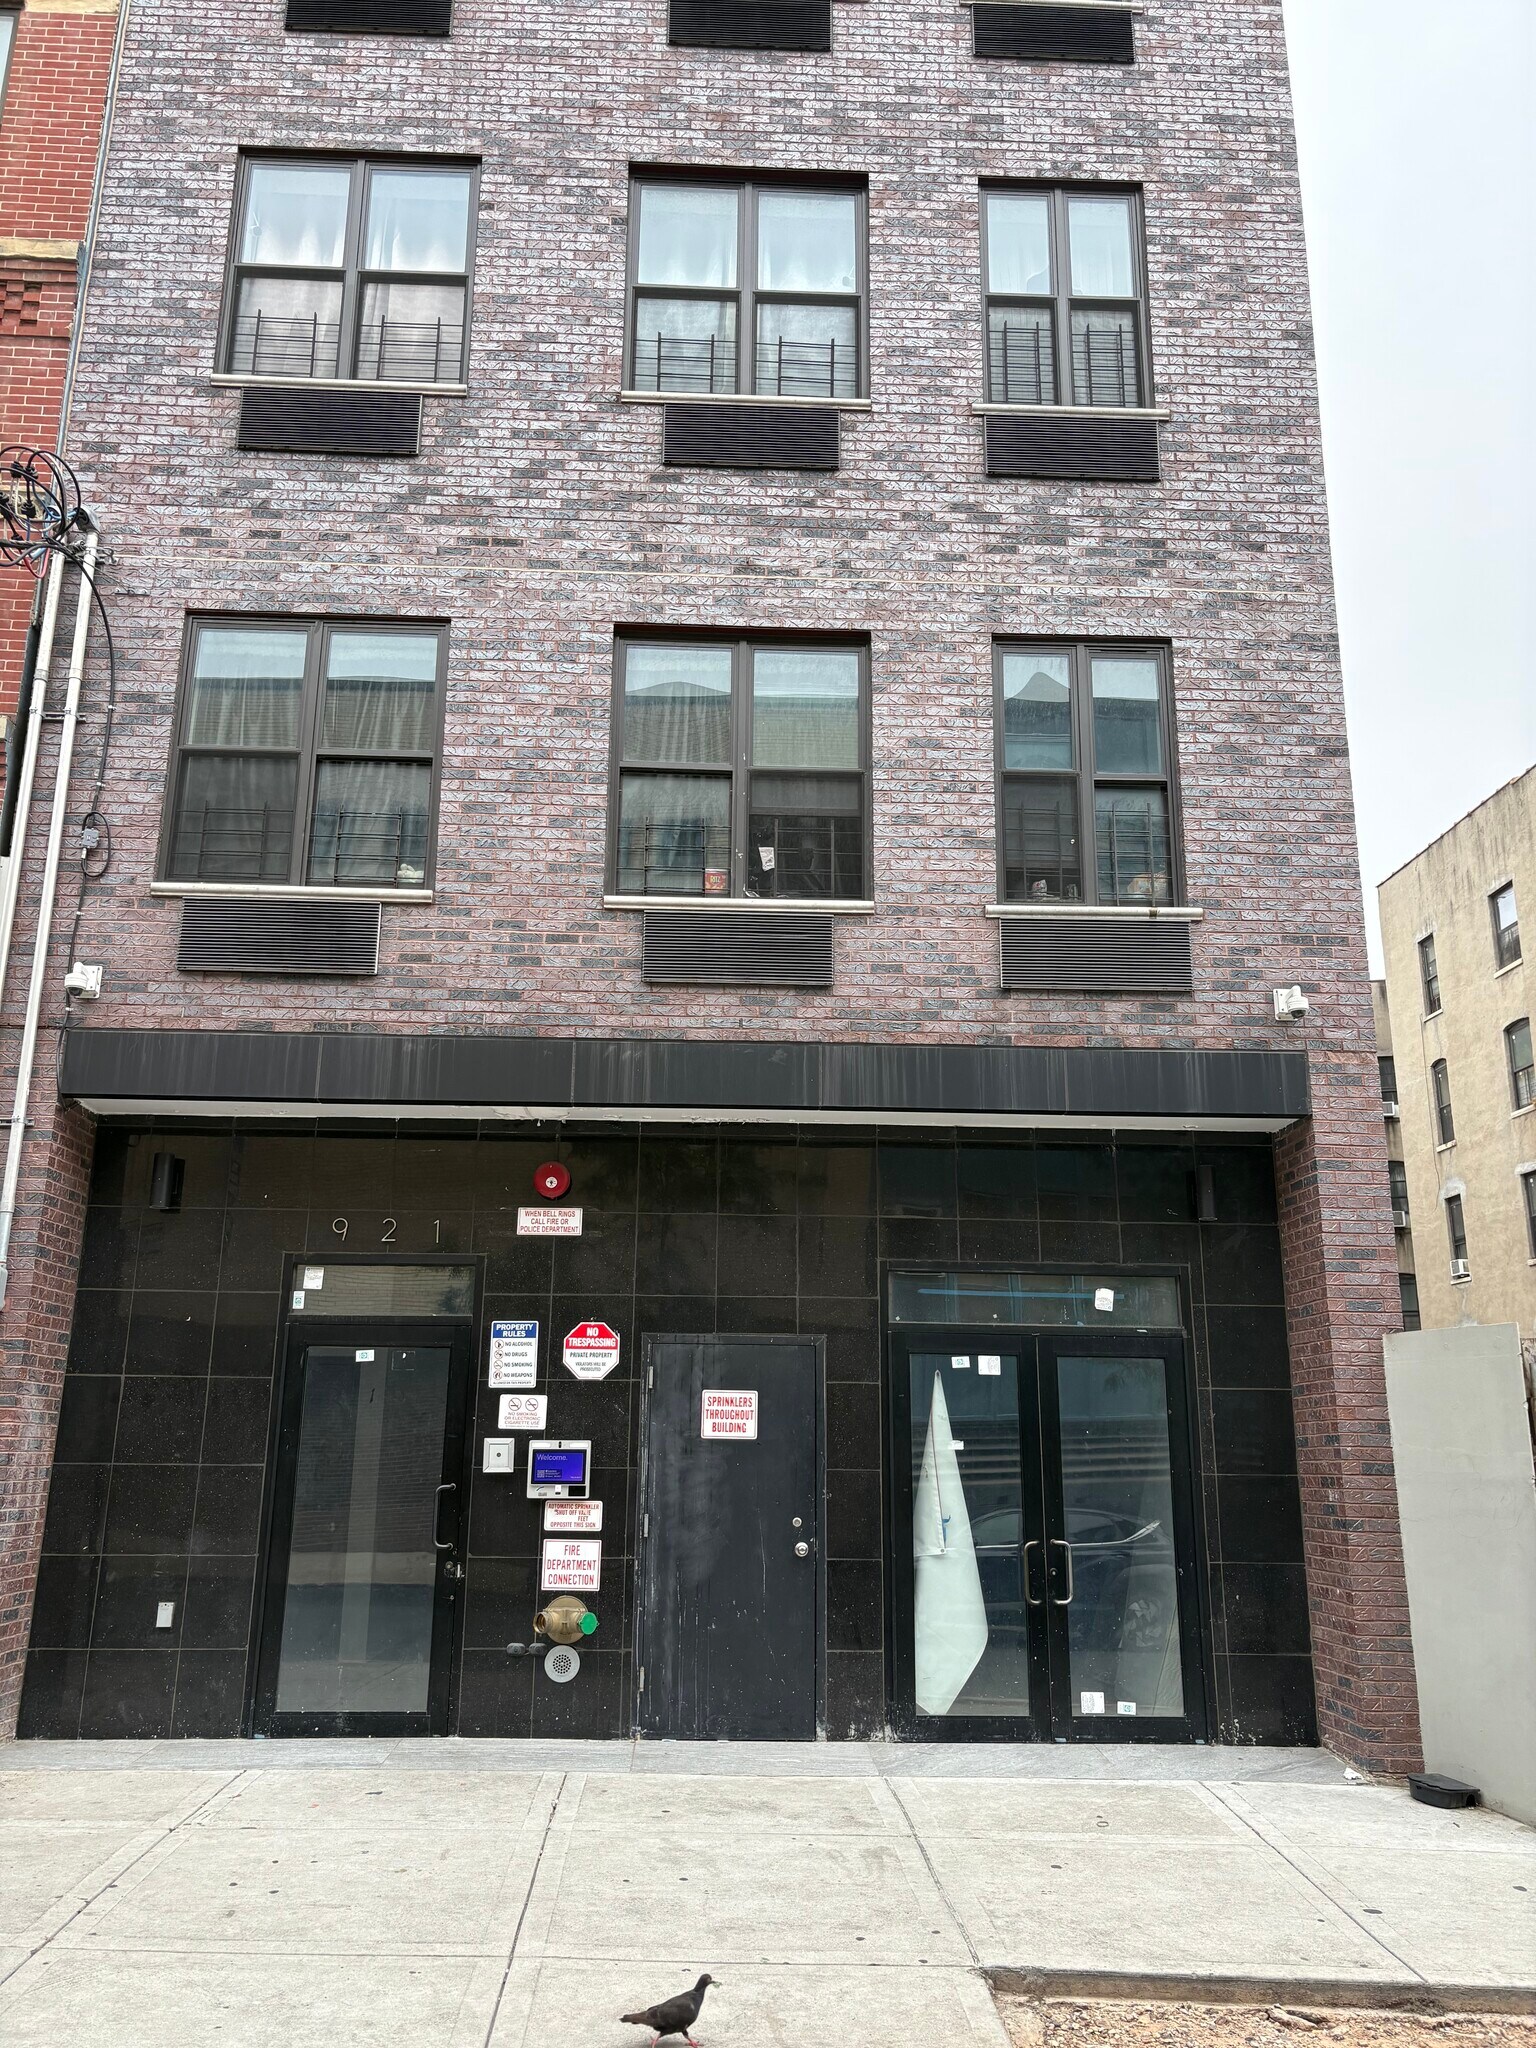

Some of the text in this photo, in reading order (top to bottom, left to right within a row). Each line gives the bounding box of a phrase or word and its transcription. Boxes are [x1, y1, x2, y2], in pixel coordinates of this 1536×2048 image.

[496, 1323, 534, 1331] PROPERTY
[586, 1327, 599, 1337] NO
[568, 1337, 616, 1347] TRESPASSING
[707, 1396, 753, 1408] SPRINKLERS
[705, 1409, 754, 1420] THROUGHOUT
[711, 1422, 747, 1433] BUILDING
[564, 1544, 581, 1556] FIRE
[546, 1559, 597, 1571] DEPARTMENT
[548, 1573, 595, 1585] CONNECTION
